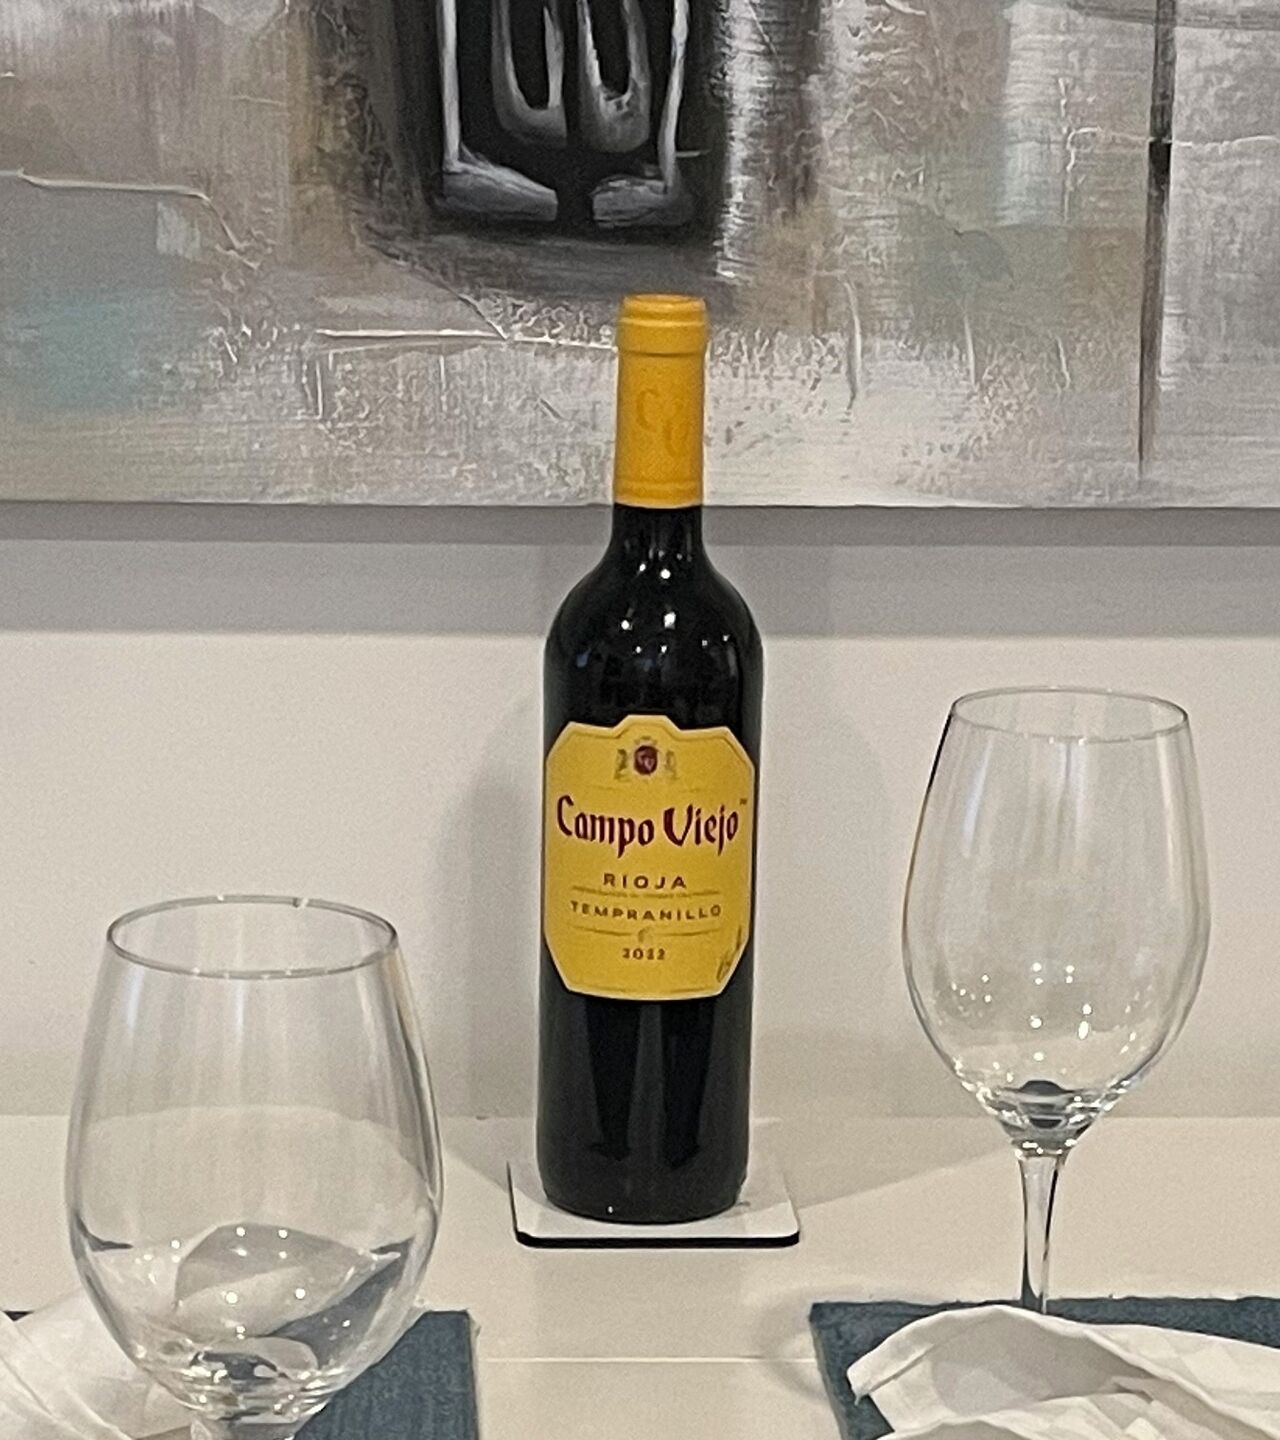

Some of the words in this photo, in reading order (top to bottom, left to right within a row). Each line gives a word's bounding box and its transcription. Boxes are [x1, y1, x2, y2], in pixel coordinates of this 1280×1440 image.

[556, 794, 655, 858] Campo
[662, 803, 739, 857] Viejo
[603, 872, 687, 889] RIOJA
[570, 900, 722, 921] TEMPRANILLO
